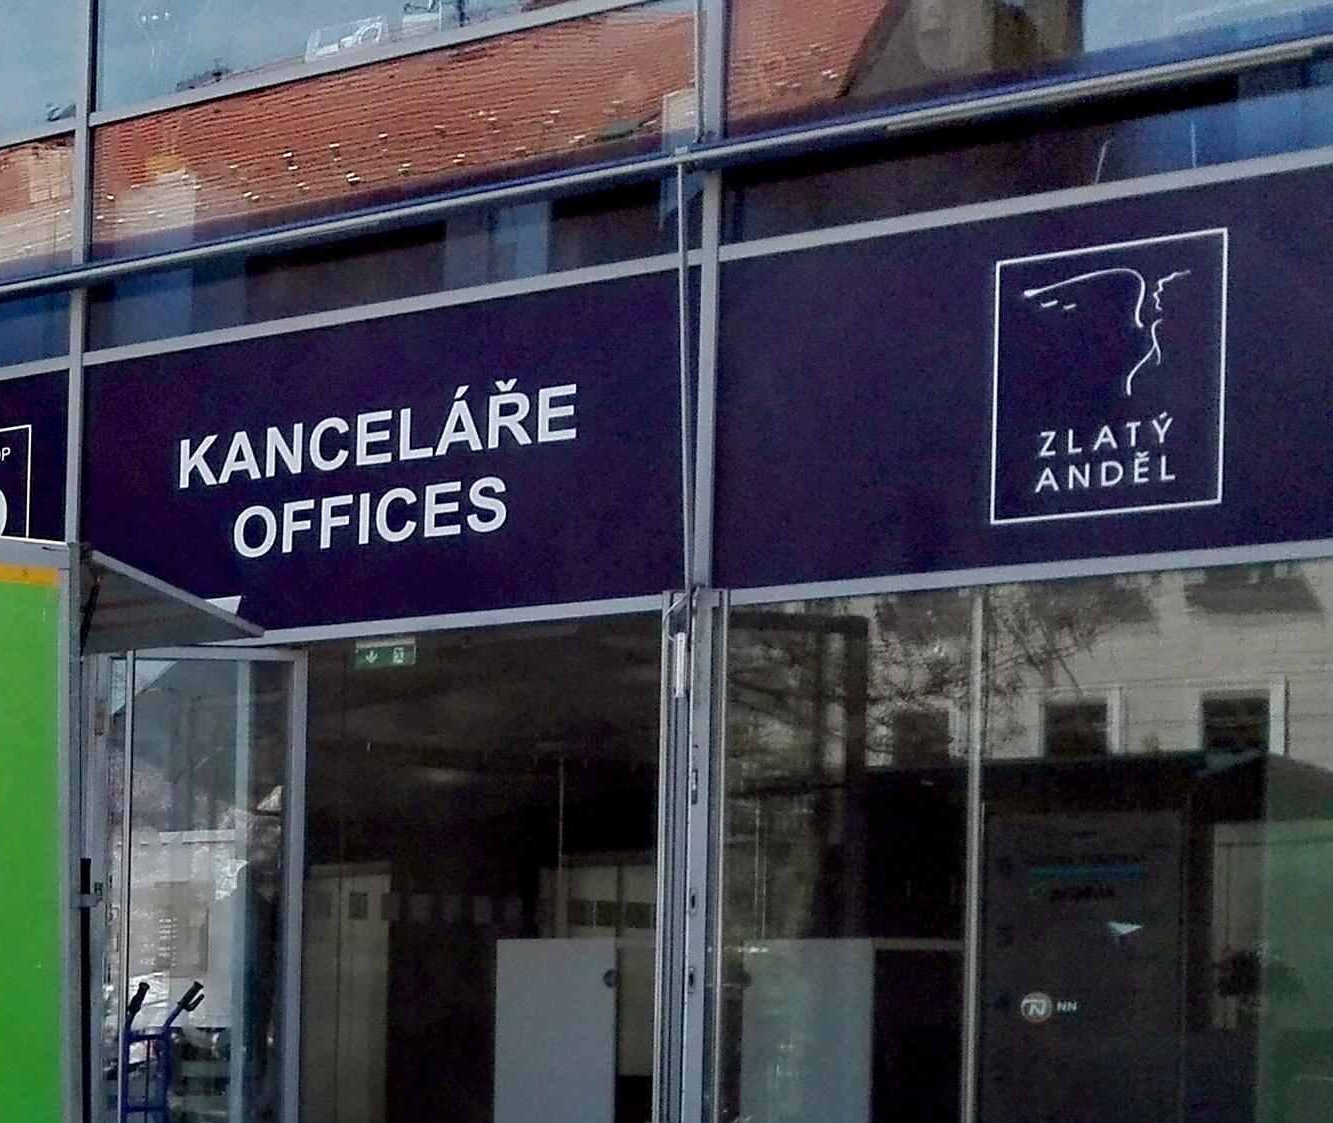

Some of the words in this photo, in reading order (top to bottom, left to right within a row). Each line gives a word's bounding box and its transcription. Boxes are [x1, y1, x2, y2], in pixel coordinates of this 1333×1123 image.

[178, 378, 578, 488] KANCELÁŘE
[1039, 411, 1174, 457] ZLATÝ
[1034, 450, 1176, 493] ANDĚL
[232, 476, 508, 559] OFFICES
